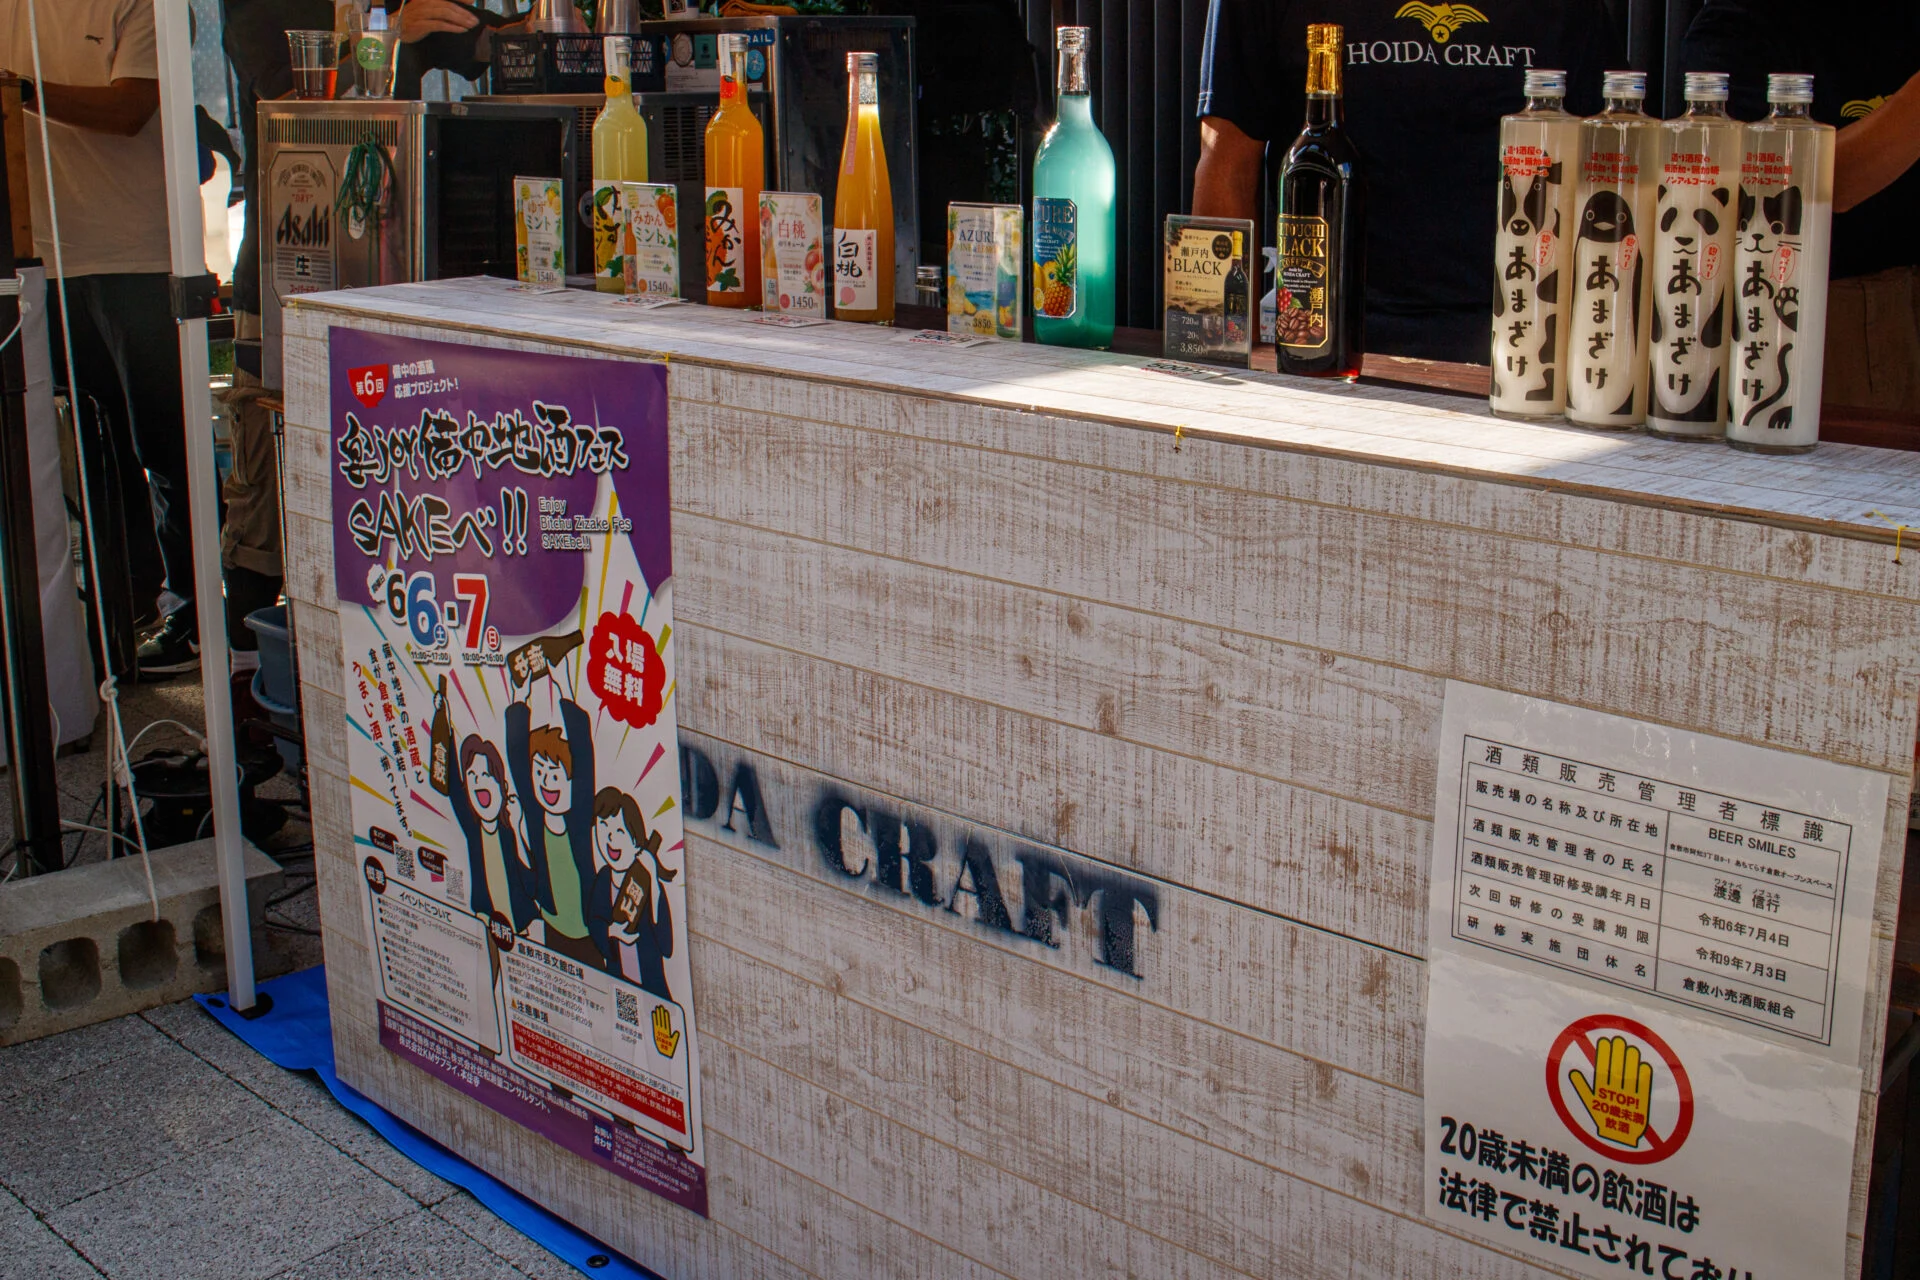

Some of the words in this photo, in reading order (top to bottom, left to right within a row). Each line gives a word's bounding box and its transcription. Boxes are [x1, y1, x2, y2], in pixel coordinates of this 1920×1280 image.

[1347, 40, 1440, 65] HOIDA
[1444, 43, 1536, 68] CRAFT
[526, 214, 551, 231] ミント
[527, 200, 546, 214] ゆず
[634, 210, 663, 226] みかん
[276, 203, 330, 247] Asahi
[636, 227, 664, 244] ミント
[710, 200, 741, 267] みかん
[778, 219, 806, 239] 白桃
[295, 254, 311, 277] 生
[836, 231, 862, 278] 白桃
[1174, 258, 1221, 276] BLACK
[1181, 246, 1209, 259] 瀬戸内
[1309, 287, 1324, 327] 瀬戸内
[1505, 246, 1536, 377] あまざけ
[1586, 255, 1620, 389] あまざけ
[1667, 258, 1702, 396] あまざけ
[1741, 260, 1775, 401] あまざけ
[355, 370, 385, 396] 第6回
[538, 497, 566, 512] Enjoy
[540, 516, 572, 531] Bitchu
[575, 515, 610, 531] Zizake
[611, 515, 632, 531] Fes
[542, 533, 591, 549] SAKEbe!!
[606, 631, 645, 674] 入場
[603, 662, 644, 707] 無料
[1476, 779, 1658, 838] 販売場の名称及び所在地
[1485, 745, 1823, 842] 酒類販売管理者標識
[1472, 818, 1654, 877] 酒類販売管理者の氏名
[1709, 828, 1743, 846] BEER
[1747, 837, 1796, 859] SMILES
[815, 789, 1158, 981] CRAFT
[1471, 851, 1651, 911] 酒類販売管理研修受講年月日
[400, 892, 453, 923] イベントについて
[1469, 883, 1649, 944] 次回研修の受講期限
[1752, 894, 1780, 913] 信行
[490, 921, 513, 943] 場所
[1467, 915, 1647, 977] 研修実施団体名
[1698, 913, 1789, 947] 令和6年7月4日
[517, 942, 585, 981] 倉敷市芸文館広場
[1696, 947, 1787, 982] 令和9年7月3日
[516, 1000, 549, 1024] 注意事項
[1683, 977, 1796, 1020] 倉敷小売酒販組合
[1592, 1099, 1645, 1126] 20歳未満
[1598, 1087, 1640, 1109] STOP!
[1604, 1116, 1630, 1134] 飲酒
[1440, 1116, 1700, 1234] 20歳未満の飲酒は
